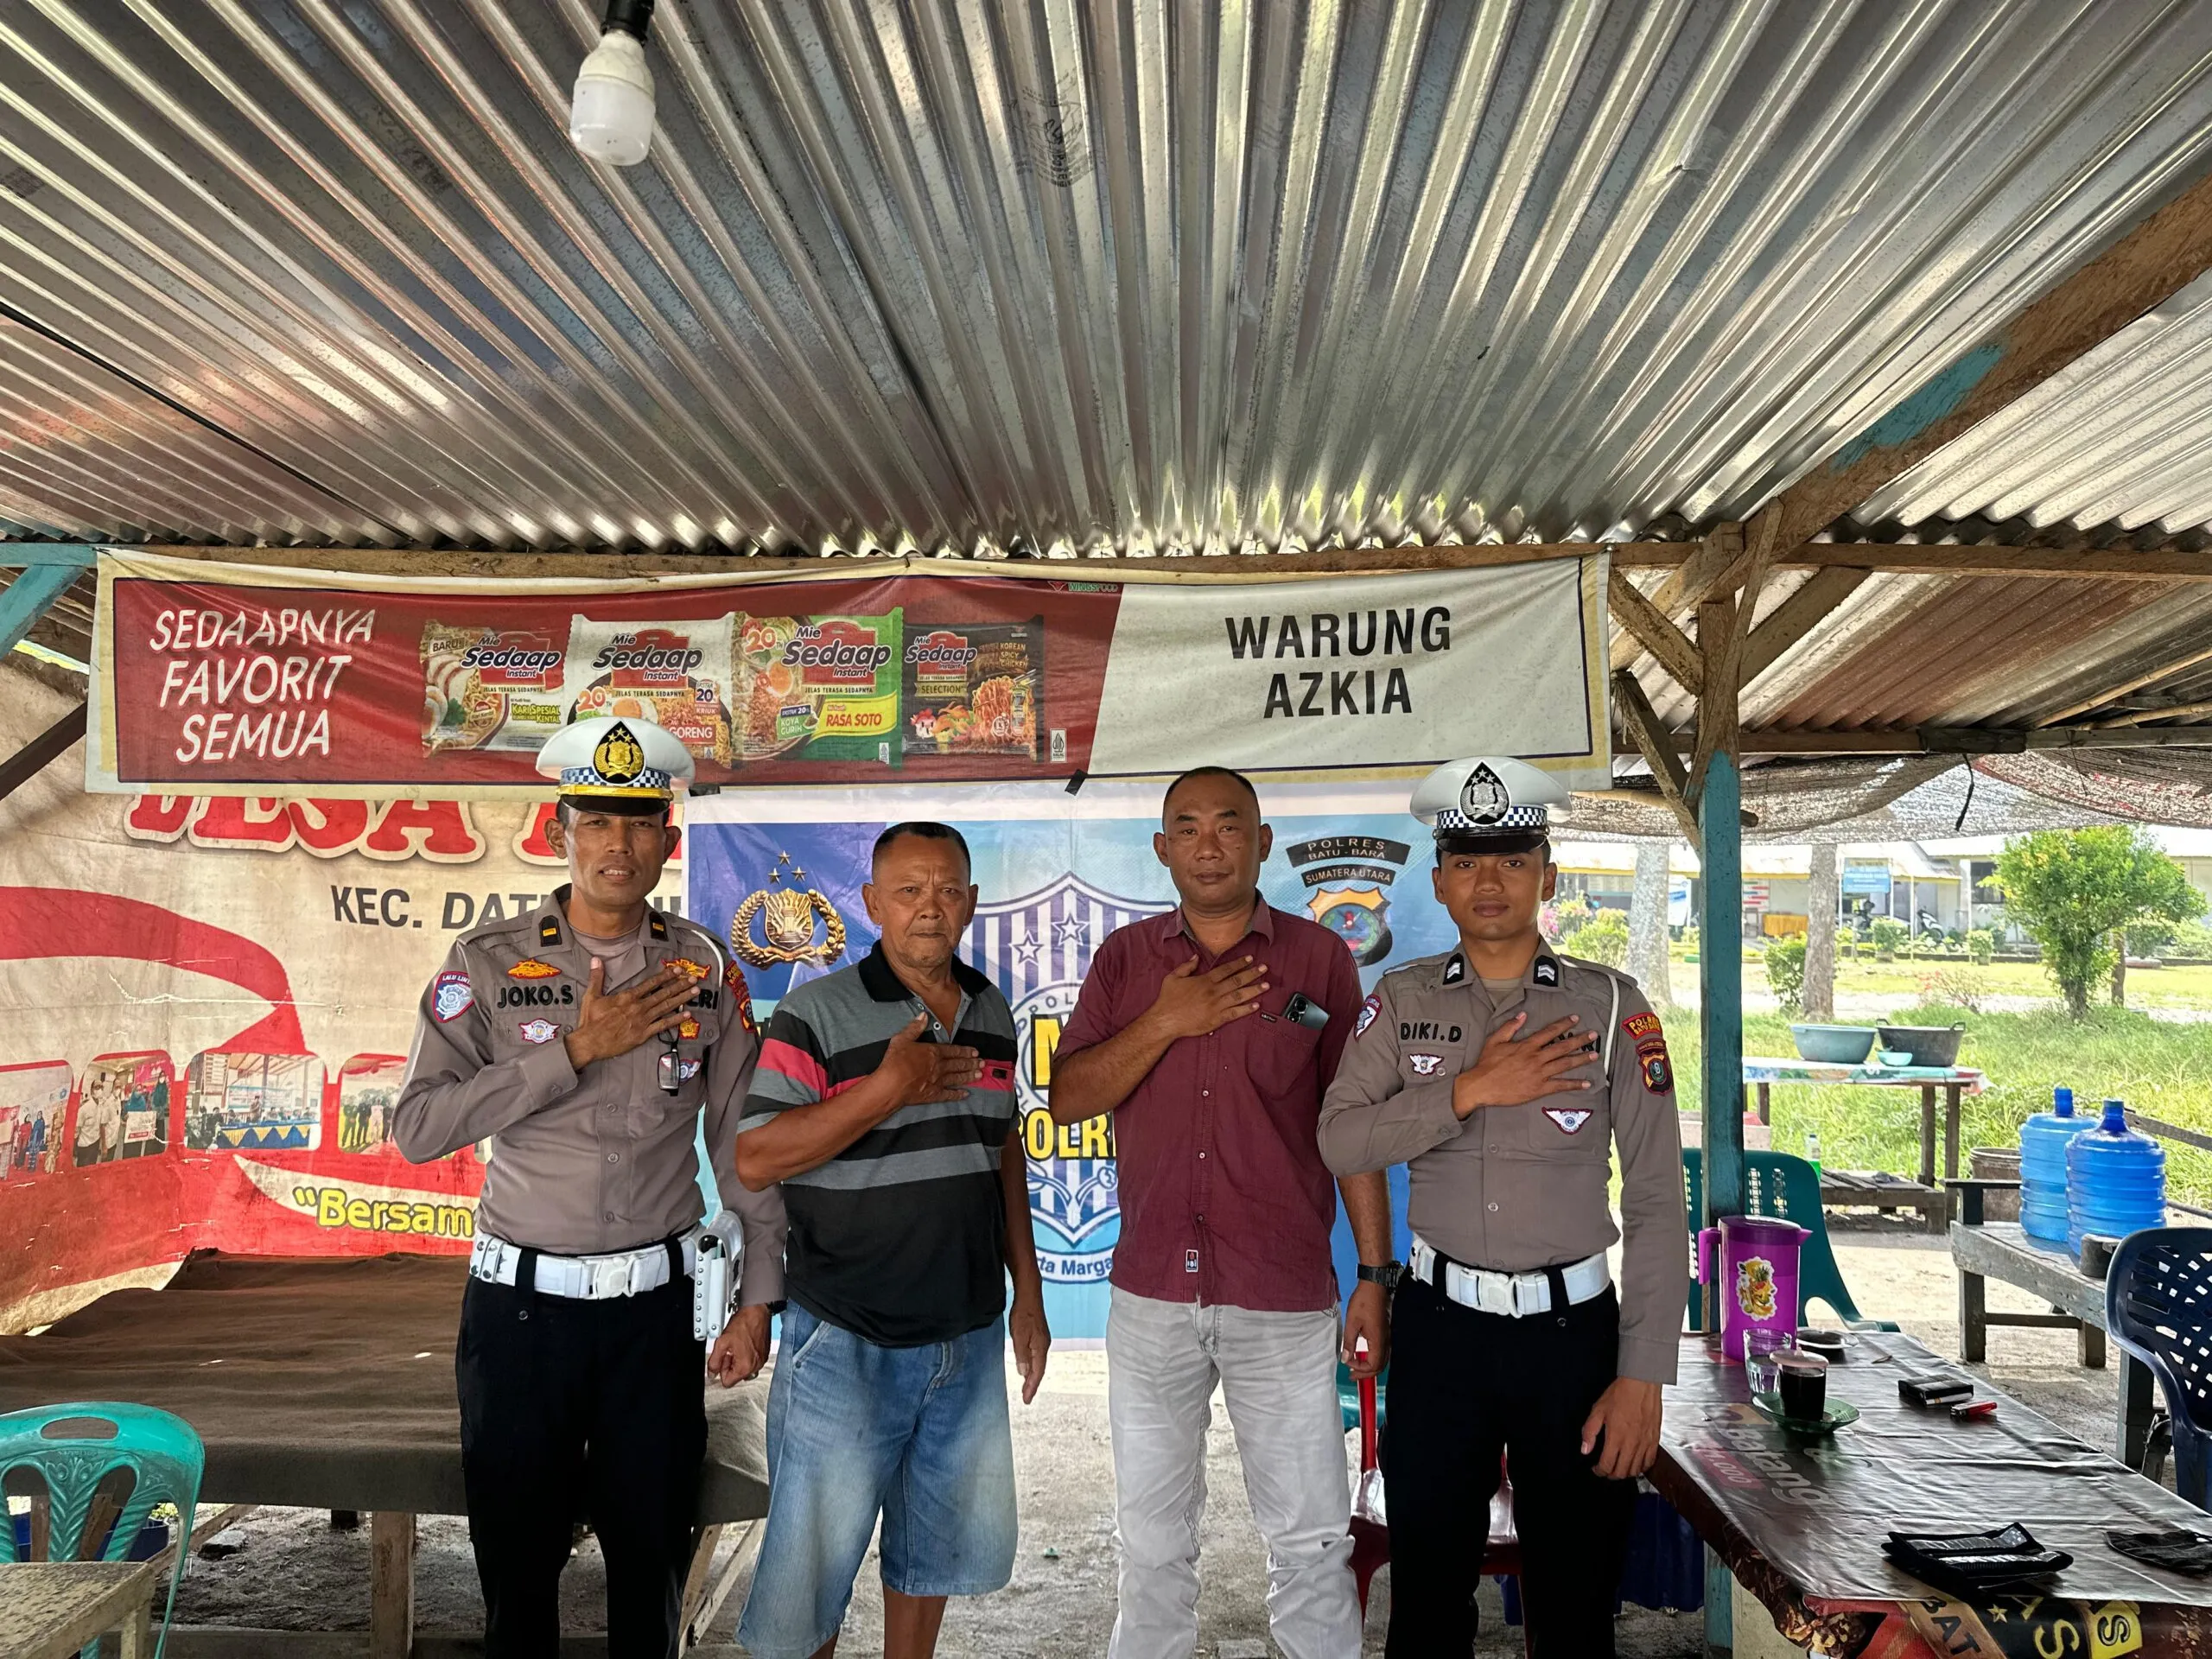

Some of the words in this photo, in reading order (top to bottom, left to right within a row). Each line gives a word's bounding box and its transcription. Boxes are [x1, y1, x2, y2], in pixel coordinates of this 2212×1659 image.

[149, 608, 376, 650] SEDAAPNYA
[796, 627, 821, 639] Mie
[1225, 607, 1452, 659] WARUNG
[478, 637, 500, 646] Mie
[612, 634, 636, 645] Mie
[745, 627, 777, 654] 20
[915, 636, 931, 645] Mie
[1000, 642, 1027, 652] KOREAN
[461, 646, 562, 672] Sedaap
[592, 645, 704, 675] Sedaap
[781, 639, 892, 671] Sedaap
[905, 645, 977, 667] Sedaap
[506, 669, 537, 677] Instant
[644, 671, 679, 681] Instant
[833, 668, 868, 677] Instant
[159, 655, 352, 708] FAVORIT
[696, 688, 714, 702] 20
[921, 685, 961, 694] SELECTION
[1263, 667, 1414, 719] AZKIA
[576, 687, 606, 712] 20
[781, 717, 799, 726] KOYA
[826, 715, 852, 728] RASA
[855, 713, 882, 727] SOTO
[175, 709, 330, 762] SEMUA
[670, 726, 713, 739] GORENG
[781, 726, 803, 734] GURIH
[1307, 838, 1385, 851] POLRES
[1308, 849, 1339, 861] BATU
[1351, 849, 1385, 859] BARA
[1306, 868, 1357, 884] SUMATERA
[1358, 868, 1391, 882] UTARA
[331, 885, 423, 928] KEC.
[497, 984, 575, 1009] JOKO.S
[1400, 1022, 1462, 1042] DIKI.D
